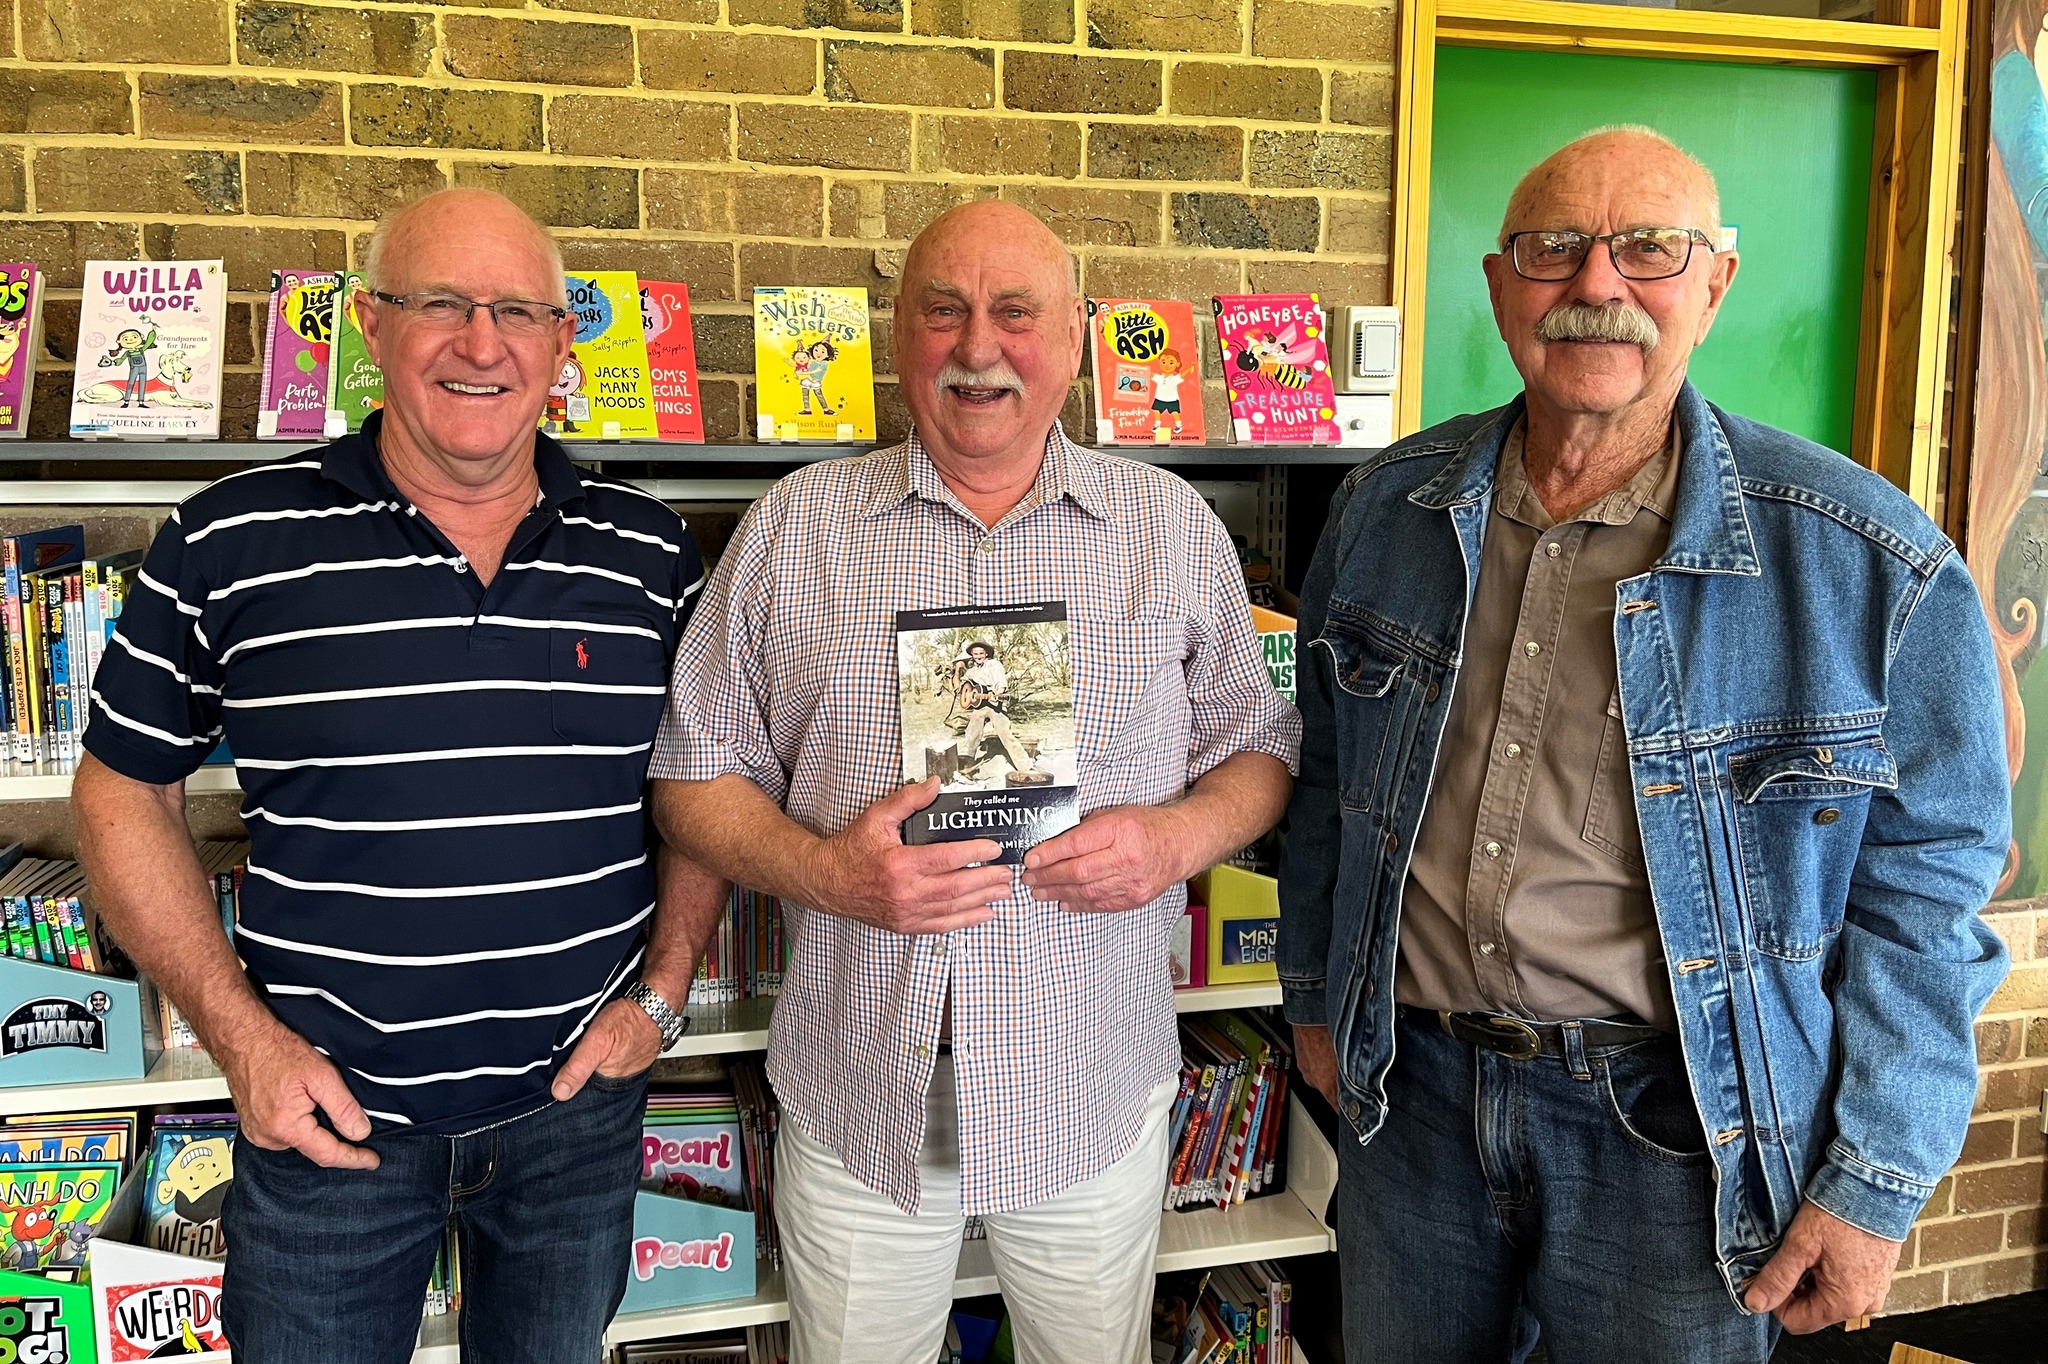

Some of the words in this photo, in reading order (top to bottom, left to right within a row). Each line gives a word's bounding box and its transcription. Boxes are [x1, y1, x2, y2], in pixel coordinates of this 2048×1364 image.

[307, 276, 322, 286] ASH
[128, 295, 195, 312] WOOF
[790, 291, 808, 299] The
[762, 297, 826, 322] Wish
[1117, 303, 1129, 312] ASH
[1129, 302, 1149, 311] BARTY
[1114, 312, 1157, 338] Little
[1222, 304, 1314, 335] HONEYBEE
[785, 318, 856, 341] Sisters
[156, 335, 208, 345] Grandparents
[592, 342, 611, 352] Sally
[612, 337, 638, 350] Rippin
[1116, 327, 1165, 360] ASH
[343, 373, 384, 390] Getter!
[594, 367, 640, 379] JACK'S
[285, 383, 319, 401] Party
[600, 381, 637, 394] MANY
[653, 385, 692, 397] ECIAL
[277, 395, 326, 416] Problem!
[594, 397, 646, 409] MOODS
[1234, 391, 1324, 417] TREASURE
[1108, 406, 1150, 420] Friendship
[1270, 406, 1318, 426] HUNT
[84, 569, 92, 588] 2019
[99, 591, 107, 610] 2018
[1258, 632, 1297, 664] AR
[18, 688, 26, 720] ZAPPED!
[963, 797, 982, 807] They
[983, 795, 1007, 805] called
[927, 805, 1055, 831] LIGHTNING
[4, 902, 12, 919] 2022
[33, 902, 42, 921] 2017
[46, 904, 54, 922] 2019
[70, 904, 78, 923] 2020
[1239, 928, 1278, 946] MAJ
[32, 1004, 69, 1020] TINY
[8, 1020, 96, 1048] TIMMY
[1180, 1076, 1190, 1093] 2017
[58, 1179, 100, 1204] DO
